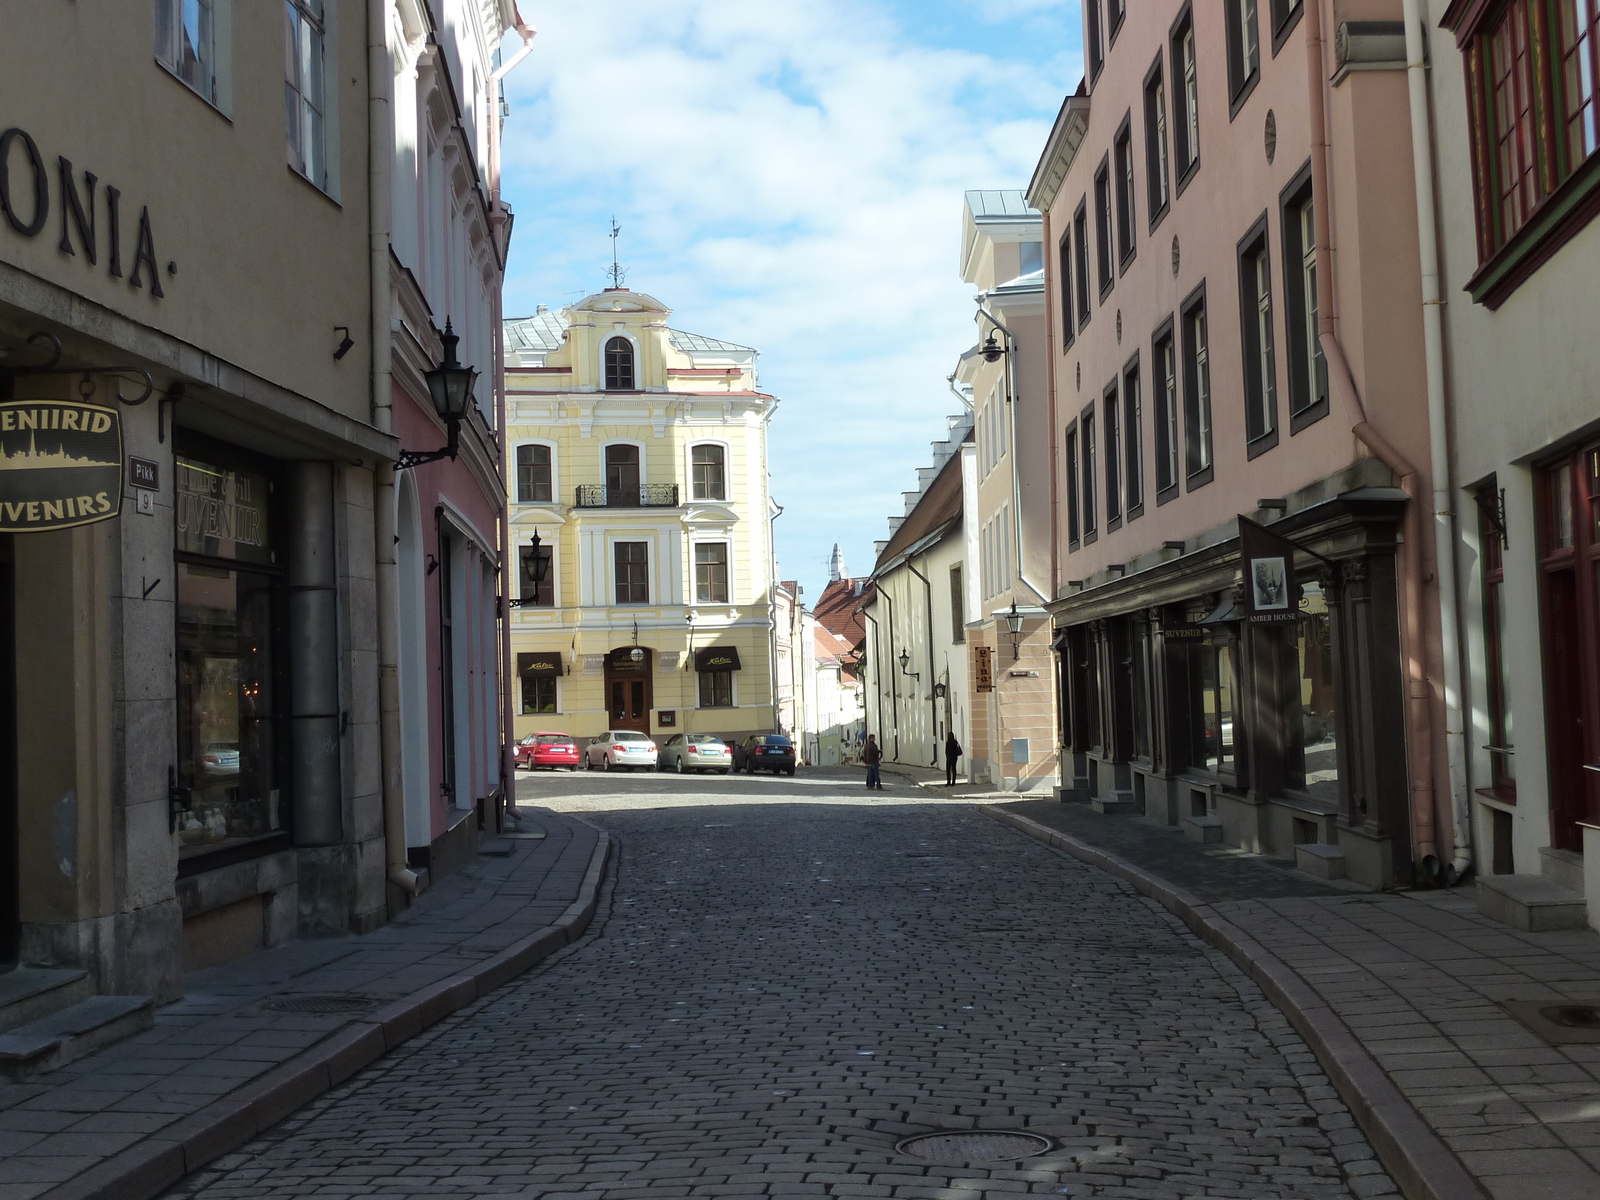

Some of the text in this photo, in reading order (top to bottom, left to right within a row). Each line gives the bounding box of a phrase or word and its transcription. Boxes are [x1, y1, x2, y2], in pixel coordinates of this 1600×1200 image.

[136, 463, 155, 481] Pikk
[0, 491, 111, 522] VENIRS
[143, 493, 149, 510] 9
[1249, 612, 1296, 623] AMBER HOUSE
[1165, 628, 1202, 638] SUVENIIR
